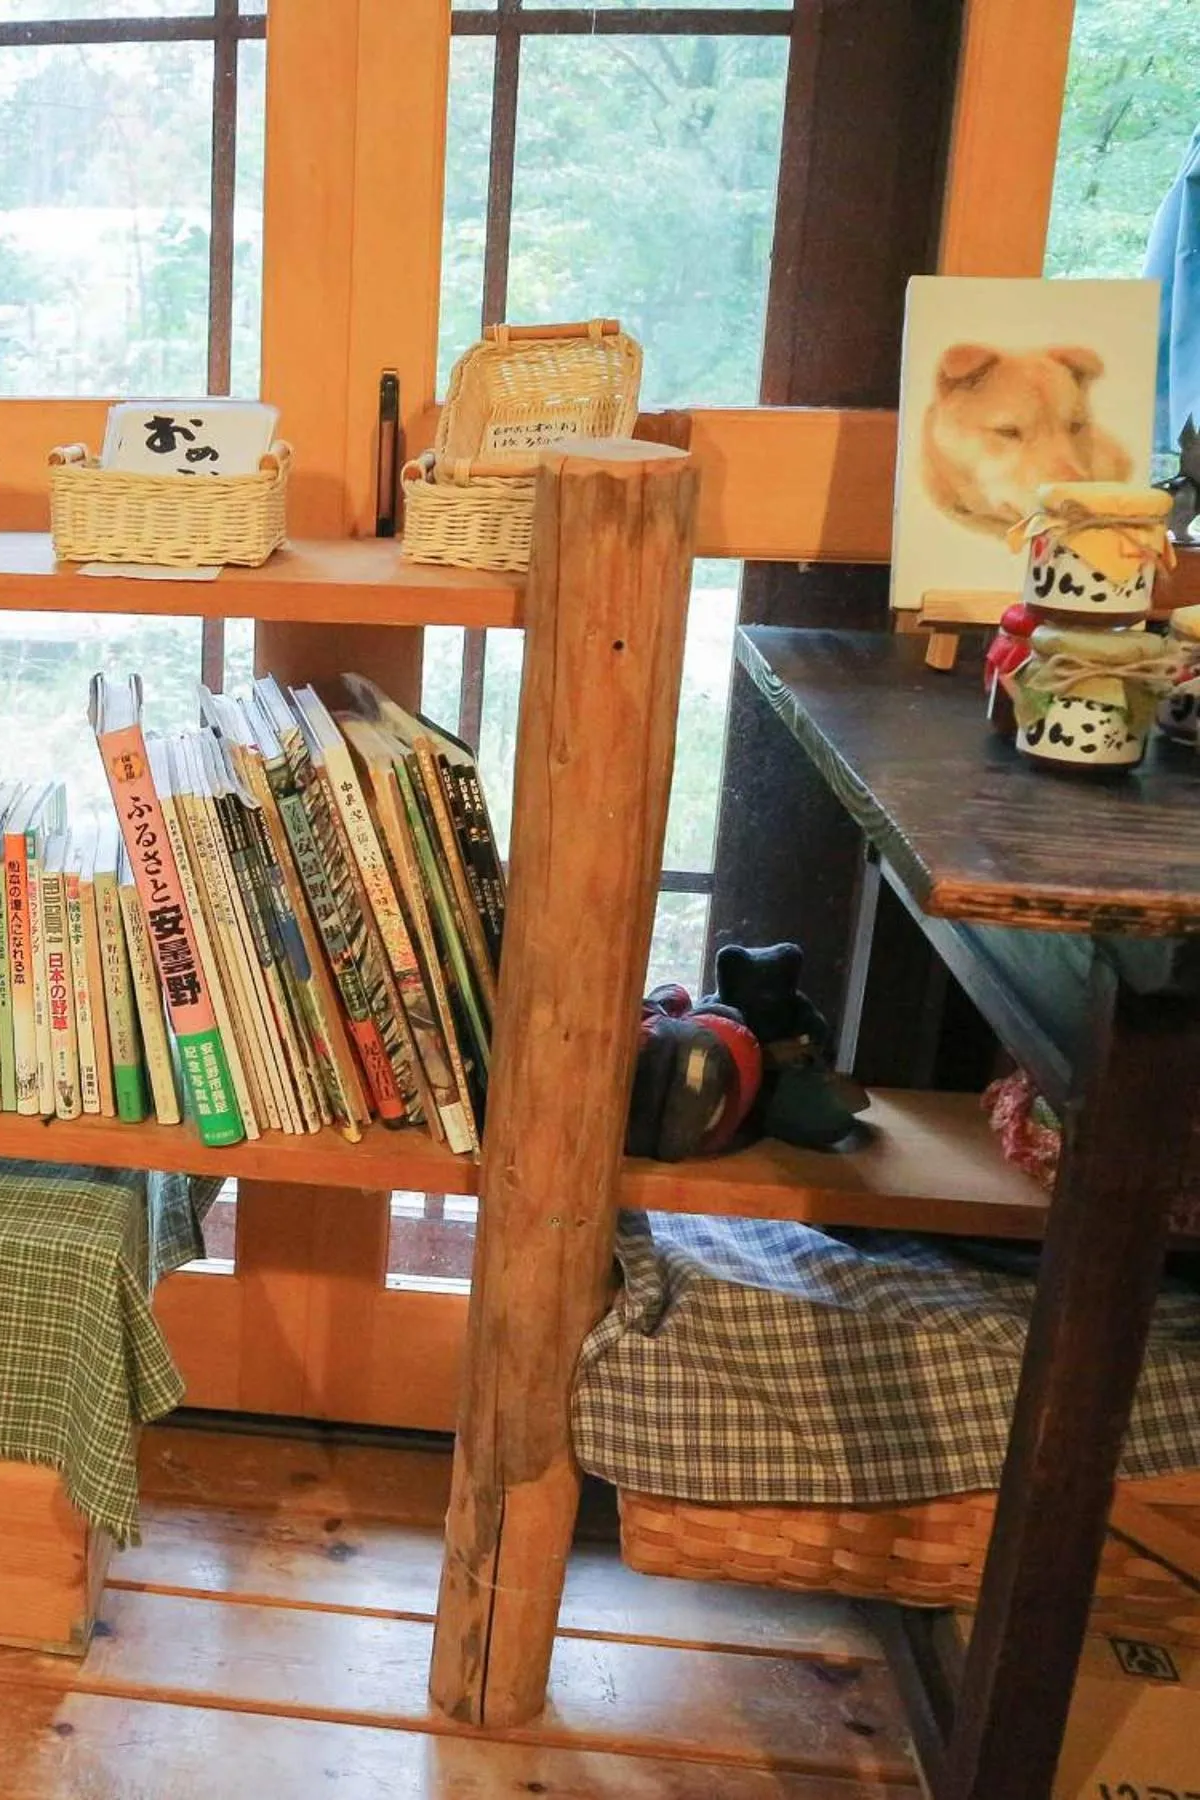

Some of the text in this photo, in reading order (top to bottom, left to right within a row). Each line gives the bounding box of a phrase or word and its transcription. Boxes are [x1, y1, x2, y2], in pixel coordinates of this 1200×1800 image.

[458, 776, 472, 811] KURA
[470, 778, 483, 811] KURA
[48, 952, 69, 1031] 日本の野草
